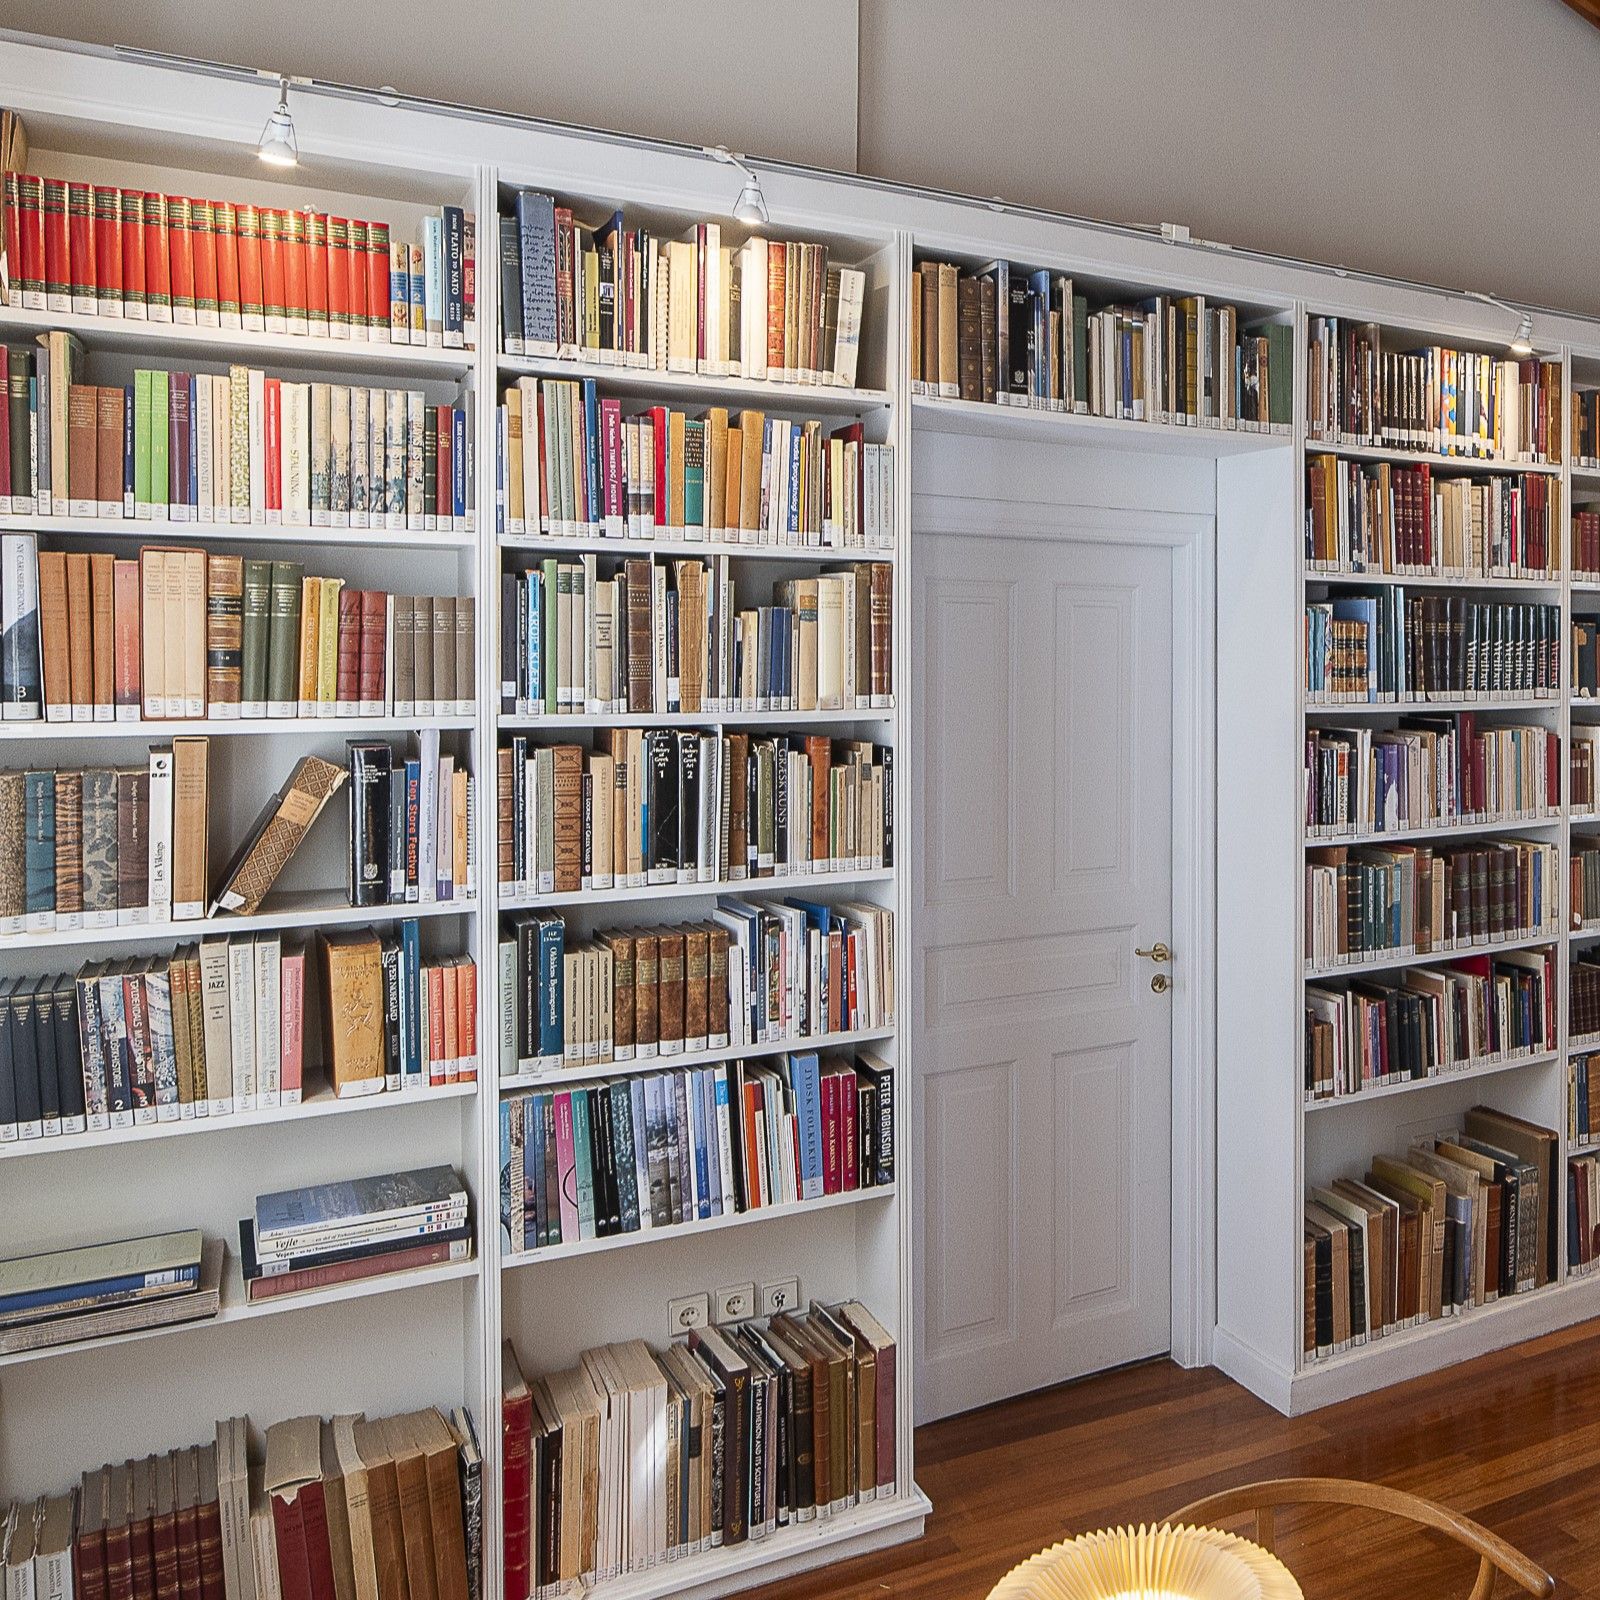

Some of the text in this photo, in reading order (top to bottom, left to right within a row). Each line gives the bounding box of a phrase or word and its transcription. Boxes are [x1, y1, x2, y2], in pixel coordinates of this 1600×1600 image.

[450, 232, 460, 260] PLATO
[450, 270, 460, 296] NATO
[792, 436, 800, 460] Nordisk
[791, 514, 799, 530] 2001
[1466, 639, 1477, 690] Weilbac
[1480, 639, 1490, 690] Weilbac
[1493, 639, 1503, 690] Weilbac
[1504, 639, 1514, 690] Weilbac
[1515, 639, 1525, 690] Weilbac
[1526, 639, 1536, 690] Weilbac
[659, 770, 665, 779] 1
[686, 770, 694, 779] 2
[777, 748, 787, 830] GRÆSK KUNST
[408, 780, 418, 880] Den Store Festival
[208, 981, 225, 990] JAZZ
[503, 981, 514, 1048] HAMMERSHØI
[113, 1100, 124, 1111] 2
[139, 1096, 149, 1107] 3
[880, 1074, 892, 1158] PETER ROBINSON
[804, 1068, 817, 1178] JYDSK FOLKEKUNS
[273, 1238, 299, 1251] Vejle
[754, 1398, 763, 1440] PARTHENON
[754, 1440, 762, 1456] AND
